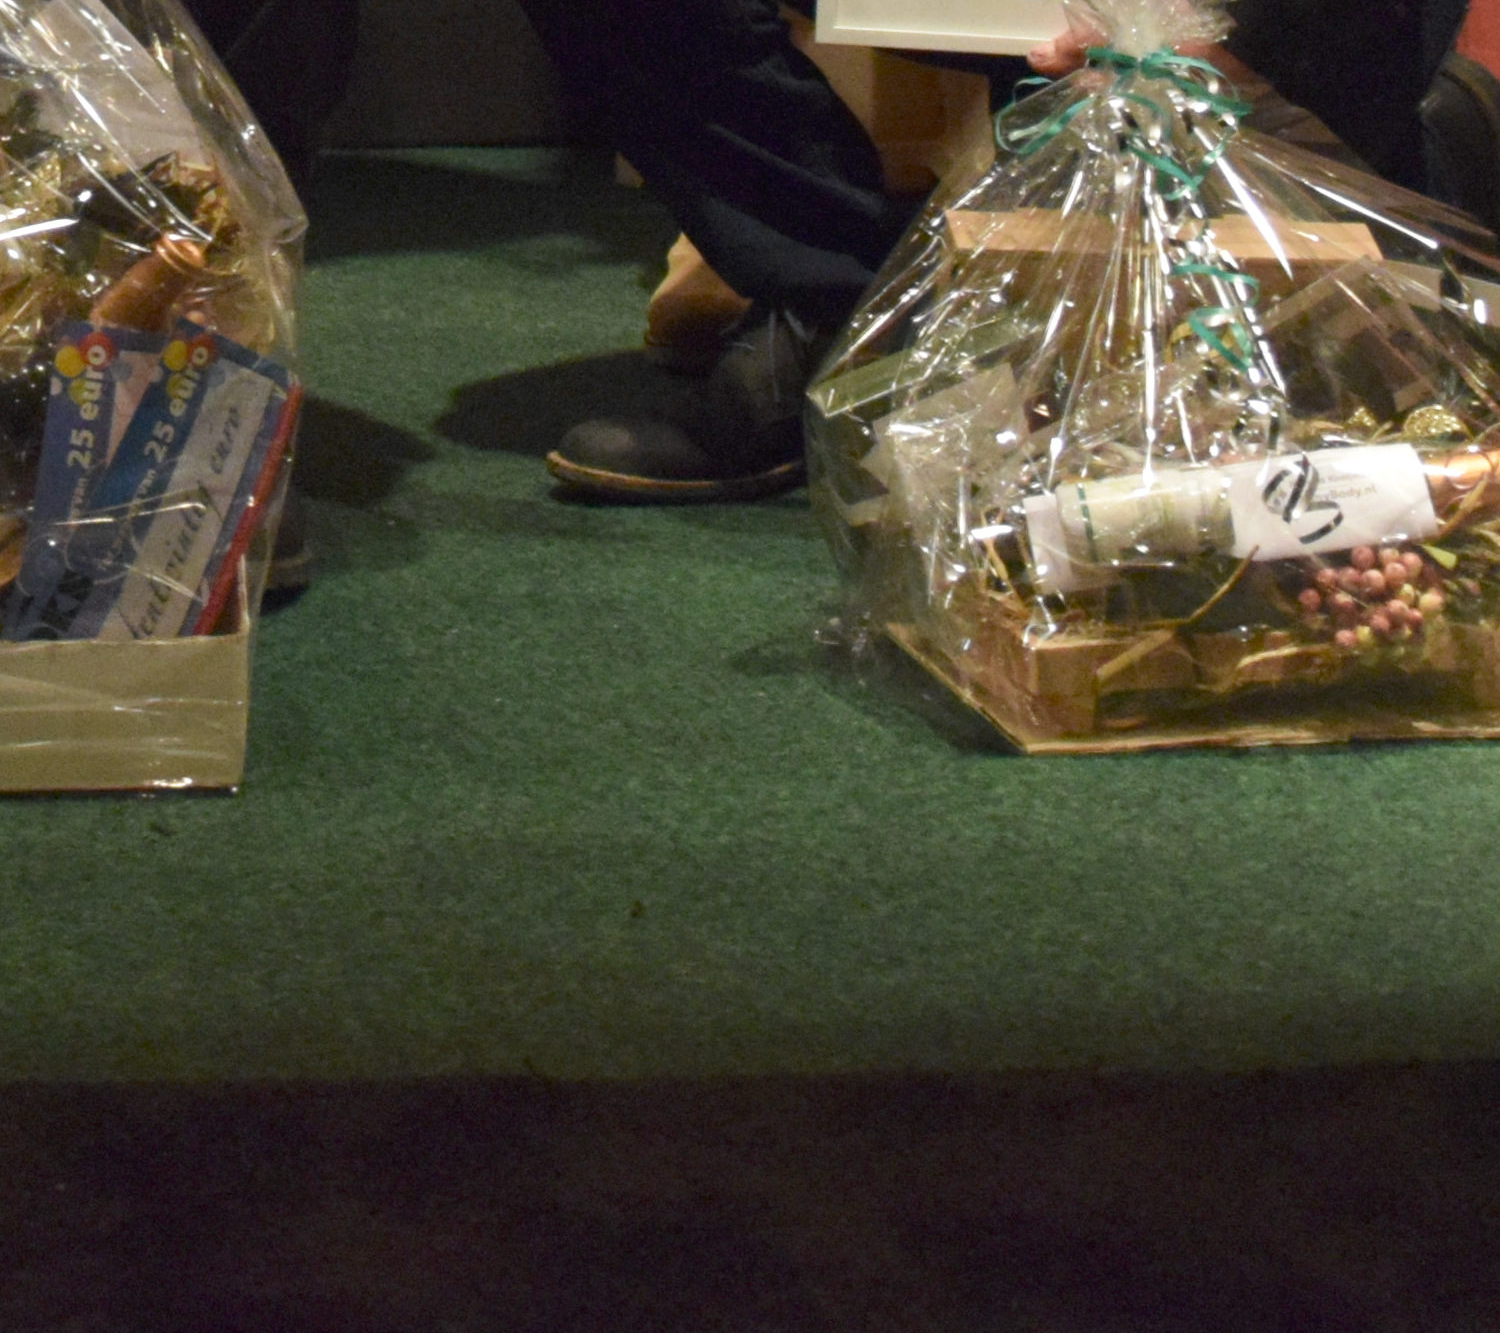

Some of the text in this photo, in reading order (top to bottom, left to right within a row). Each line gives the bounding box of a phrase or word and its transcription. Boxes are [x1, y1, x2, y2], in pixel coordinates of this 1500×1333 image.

[80, 342, 107, 422] euro
[143, 420, 176, 464] 25
[168, 343, 210, 418] euro
[66, 428, 96, 471] 25
